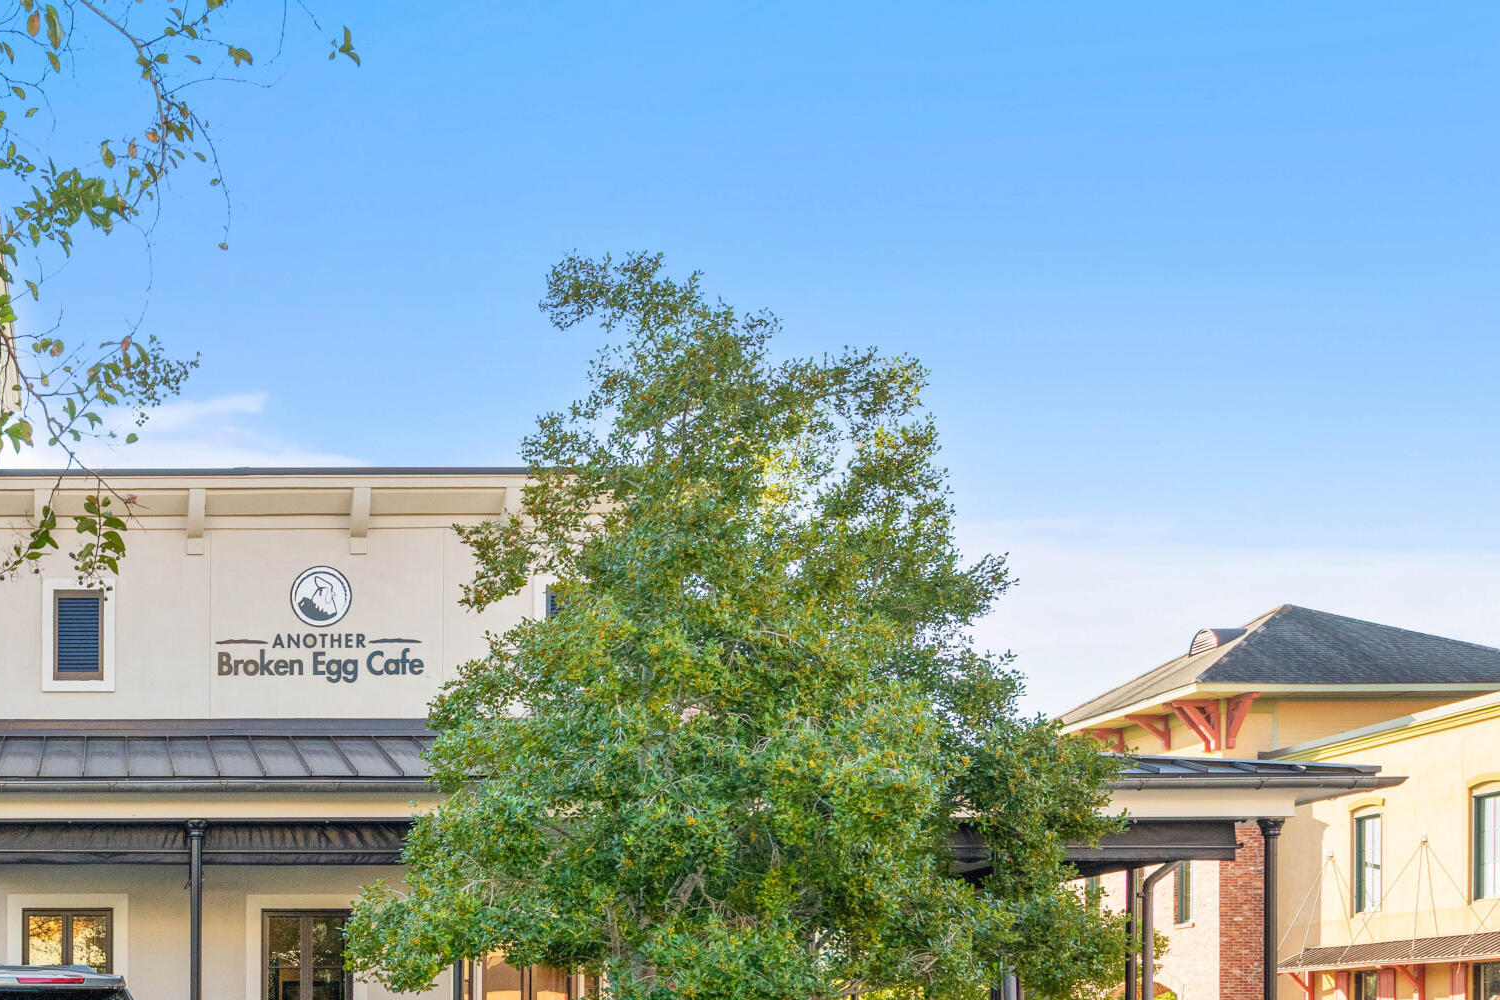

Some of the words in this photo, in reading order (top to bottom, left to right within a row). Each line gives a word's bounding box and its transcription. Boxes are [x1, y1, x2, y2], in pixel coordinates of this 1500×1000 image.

[272, 633, 366, 649] ANOTHER
[217, 648, 304, 676] Broken
[312, 651, 359, 683] Egg
[366, 647, 425, 675] Cafe
